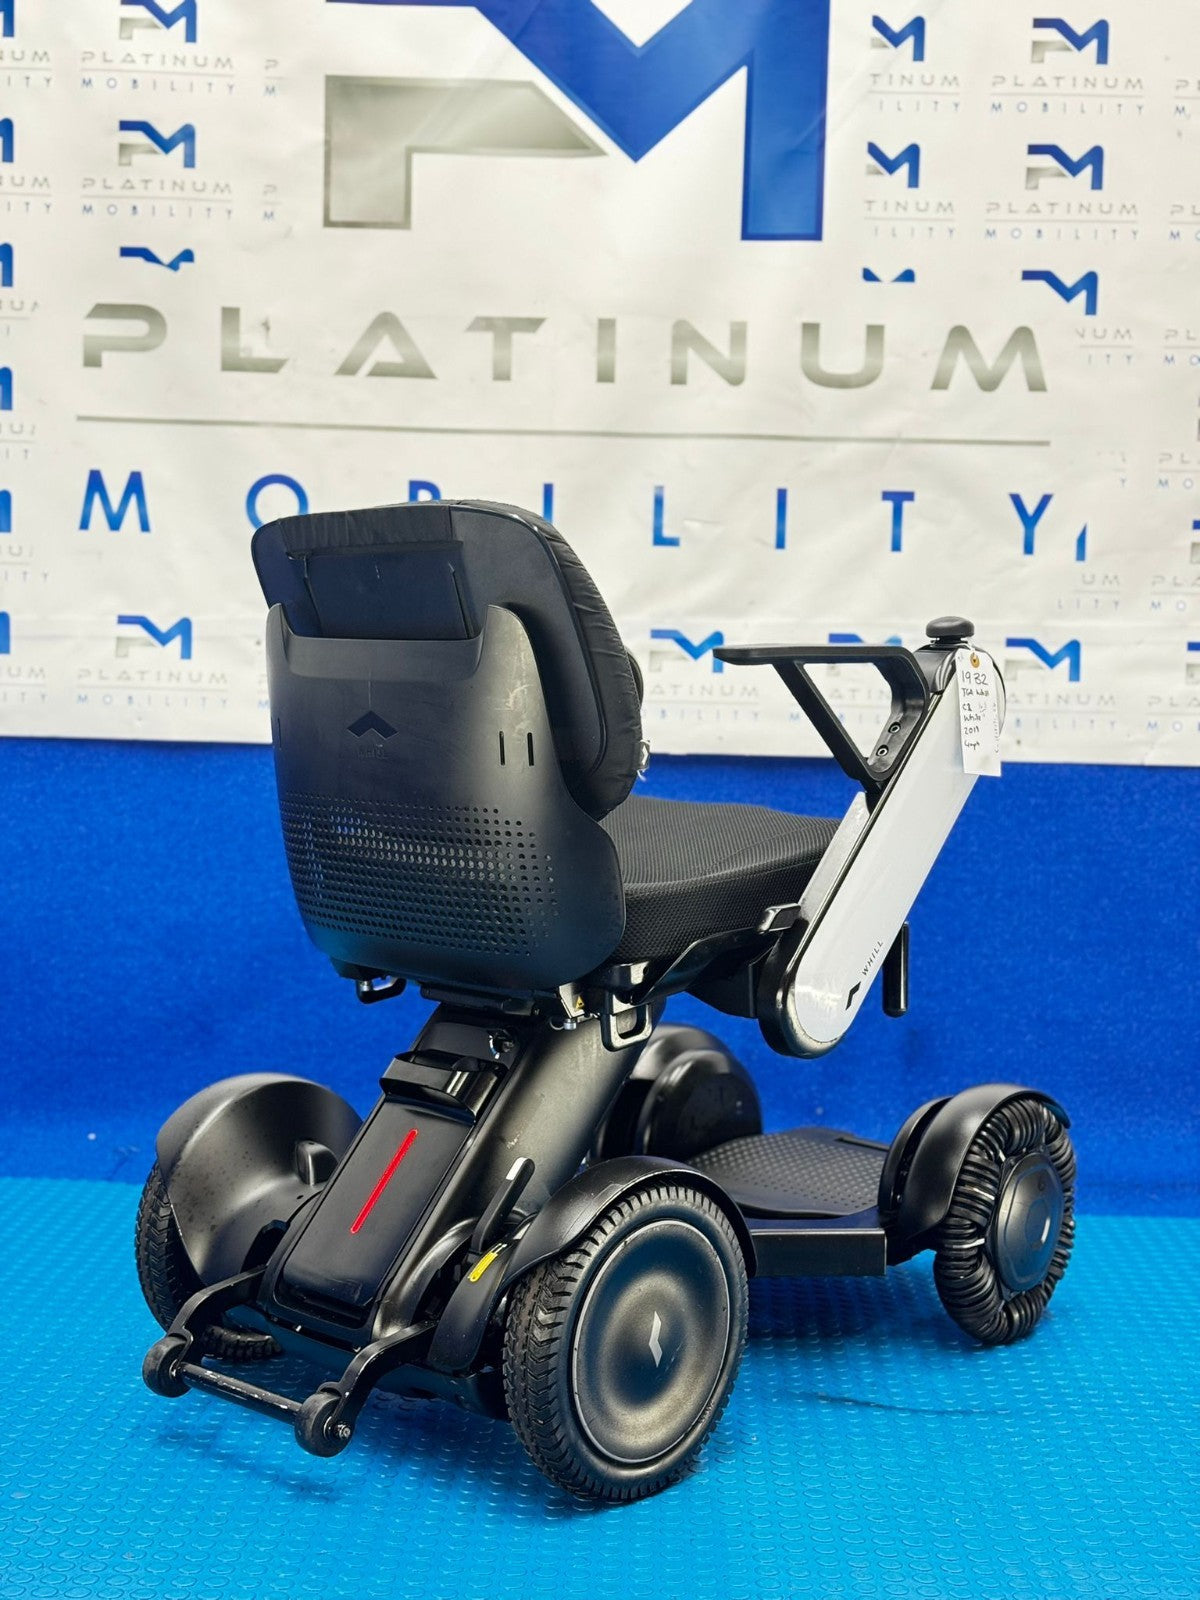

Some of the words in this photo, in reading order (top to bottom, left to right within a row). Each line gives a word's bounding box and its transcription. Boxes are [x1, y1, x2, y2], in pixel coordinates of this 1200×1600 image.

[81, 51, 234, 69] PLATINUM
[81, 77, 235, 94] MOBILITY
[991, 75, 1144, 91] PLATINUM
[990, 102, 1144, 115] MOBILITY
[82, 178, 232, 194] PLATINUM
[82, 204, 232, 221] MOBILITY
[985, 202, 1138, 216] PLATINUM
[985, 228, 1139, 241] MOBILITY
[83, 303, 1048, 392] PLATINUM
[77, 668, 227, 684] PLATINUM
[76, 694, 227, 708] MOBILITY
[862, 941, 883, 976] WHILL
